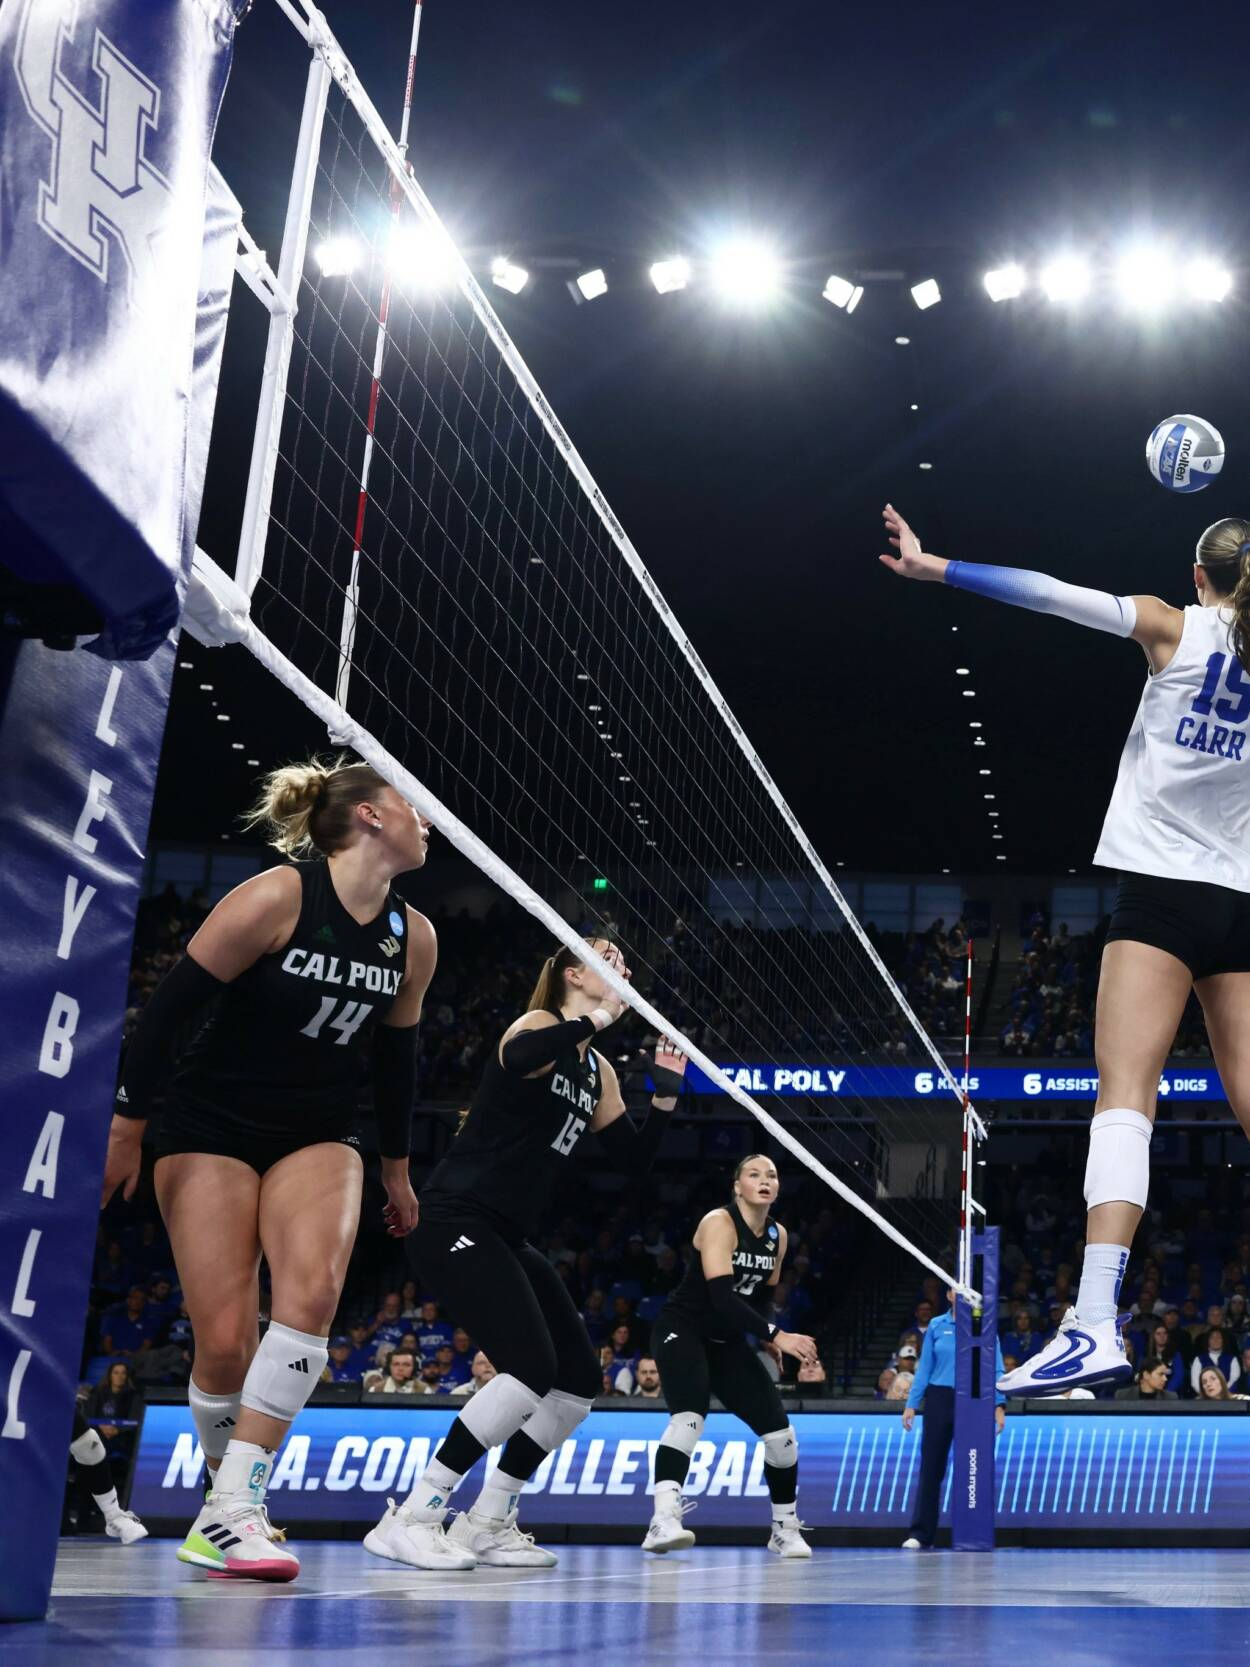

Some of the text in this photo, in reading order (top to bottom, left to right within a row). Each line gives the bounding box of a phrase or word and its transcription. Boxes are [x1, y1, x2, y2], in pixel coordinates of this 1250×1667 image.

[1174, 438, 1192, 481] molten
[1175, 716, 1247, 761] CARR
[281, 948, 404, 995] CAL POLY
[300, 996, 374, 1045] 14
[551, 1073, 576, 1104] CAL
[774, 1069, 846, 1092] POLY
[914, 1072, 934, 1093] 6
[937, 1077, 979, 1090] KILS
[1023, 1073, 1042, 1095] 6
[1174, 1079, 1207, 1091] DIGS
[550, 1112, 587, 1156] 15
[967, 1448, 978, 1509] sports imports
